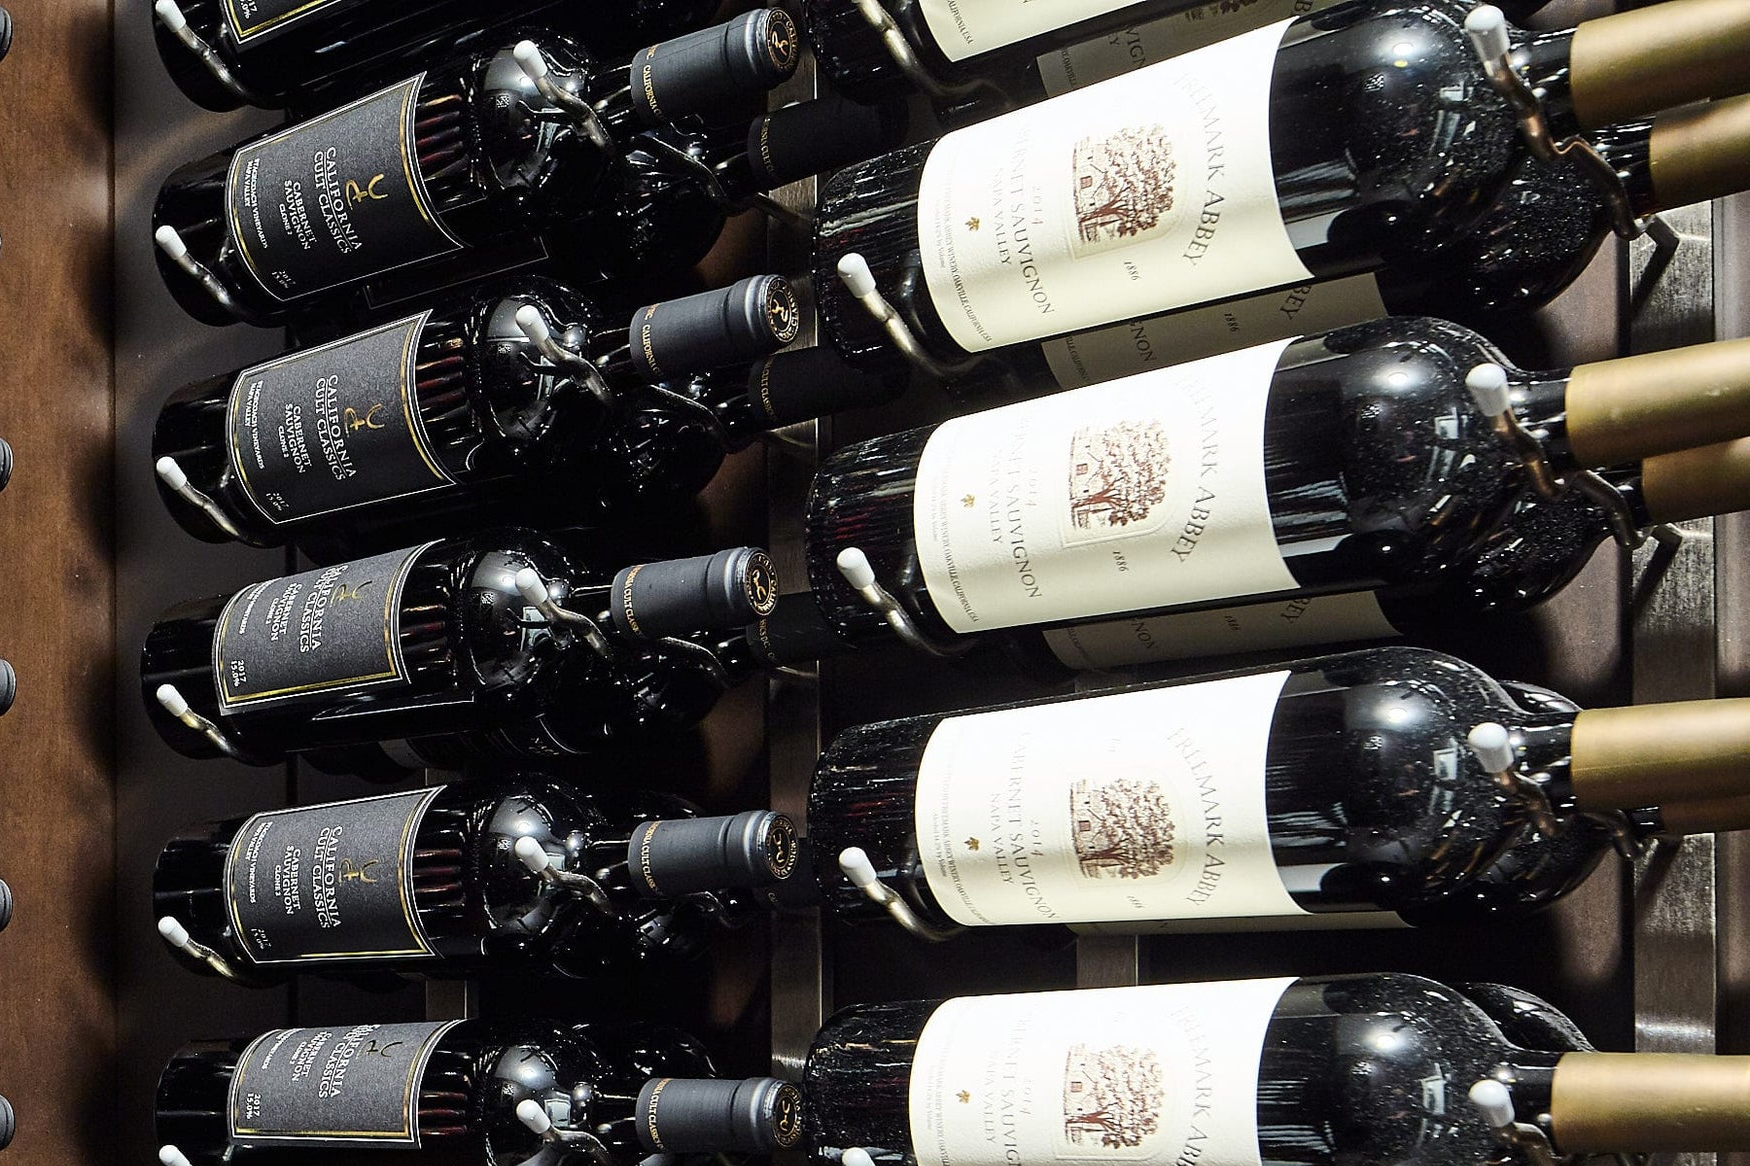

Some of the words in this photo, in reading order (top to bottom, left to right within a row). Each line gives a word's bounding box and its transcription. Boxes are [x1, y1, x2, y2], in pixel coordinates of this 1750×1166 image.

[314, 150, 327, 190] CULT
[325, 146, 363, 250] CALIFORNIA
[284, 179, 311, 250] SAUVIGNON
[293, 181, 317, 244] CABERNET
[318, 193, 352, 254] CLASSICS
[993, 210, 1013, 266] VALLEY
[1182, 189, 1226, 267] ABBEY
[1009, 202, 1056, 316] SAUVIGNON
[315, 377, 327, 416] CULT
[326, 374, 357, 478] CALIFORNIA
[284, 403, 306, 474] SAUVIGNON
[294, 405, 313, 467] CABERNET
[316, 419, 346, 481] CLASSICS
[1005, 484, 1043, 600] SAUVIGNON
[1170, 486, 1217, 563] ABBEY
[1112, 549, 1130, 573] 1886
[299, 591, 319, 653] CLASSICS
[236, 659, 247, 683] 2017
[1167, 727, 1225, 847] FREEMARK
[313, 826, 330, 862] CULT
[993, 836, 1015, 886] VALLEY
[282, 845, 295, 916] SAUVIGNON
[290, 848, 301, 910] CABERNET
[312, 864, 331, 929] CLASSICS
[323, 825, 344, 928] CALIFORNIA
[1010, 833, 1060, 920] SAUVIGNON
[1186, 852, 1226, 907] ABBEY
[253, 1093, 262, 1118] 2017
